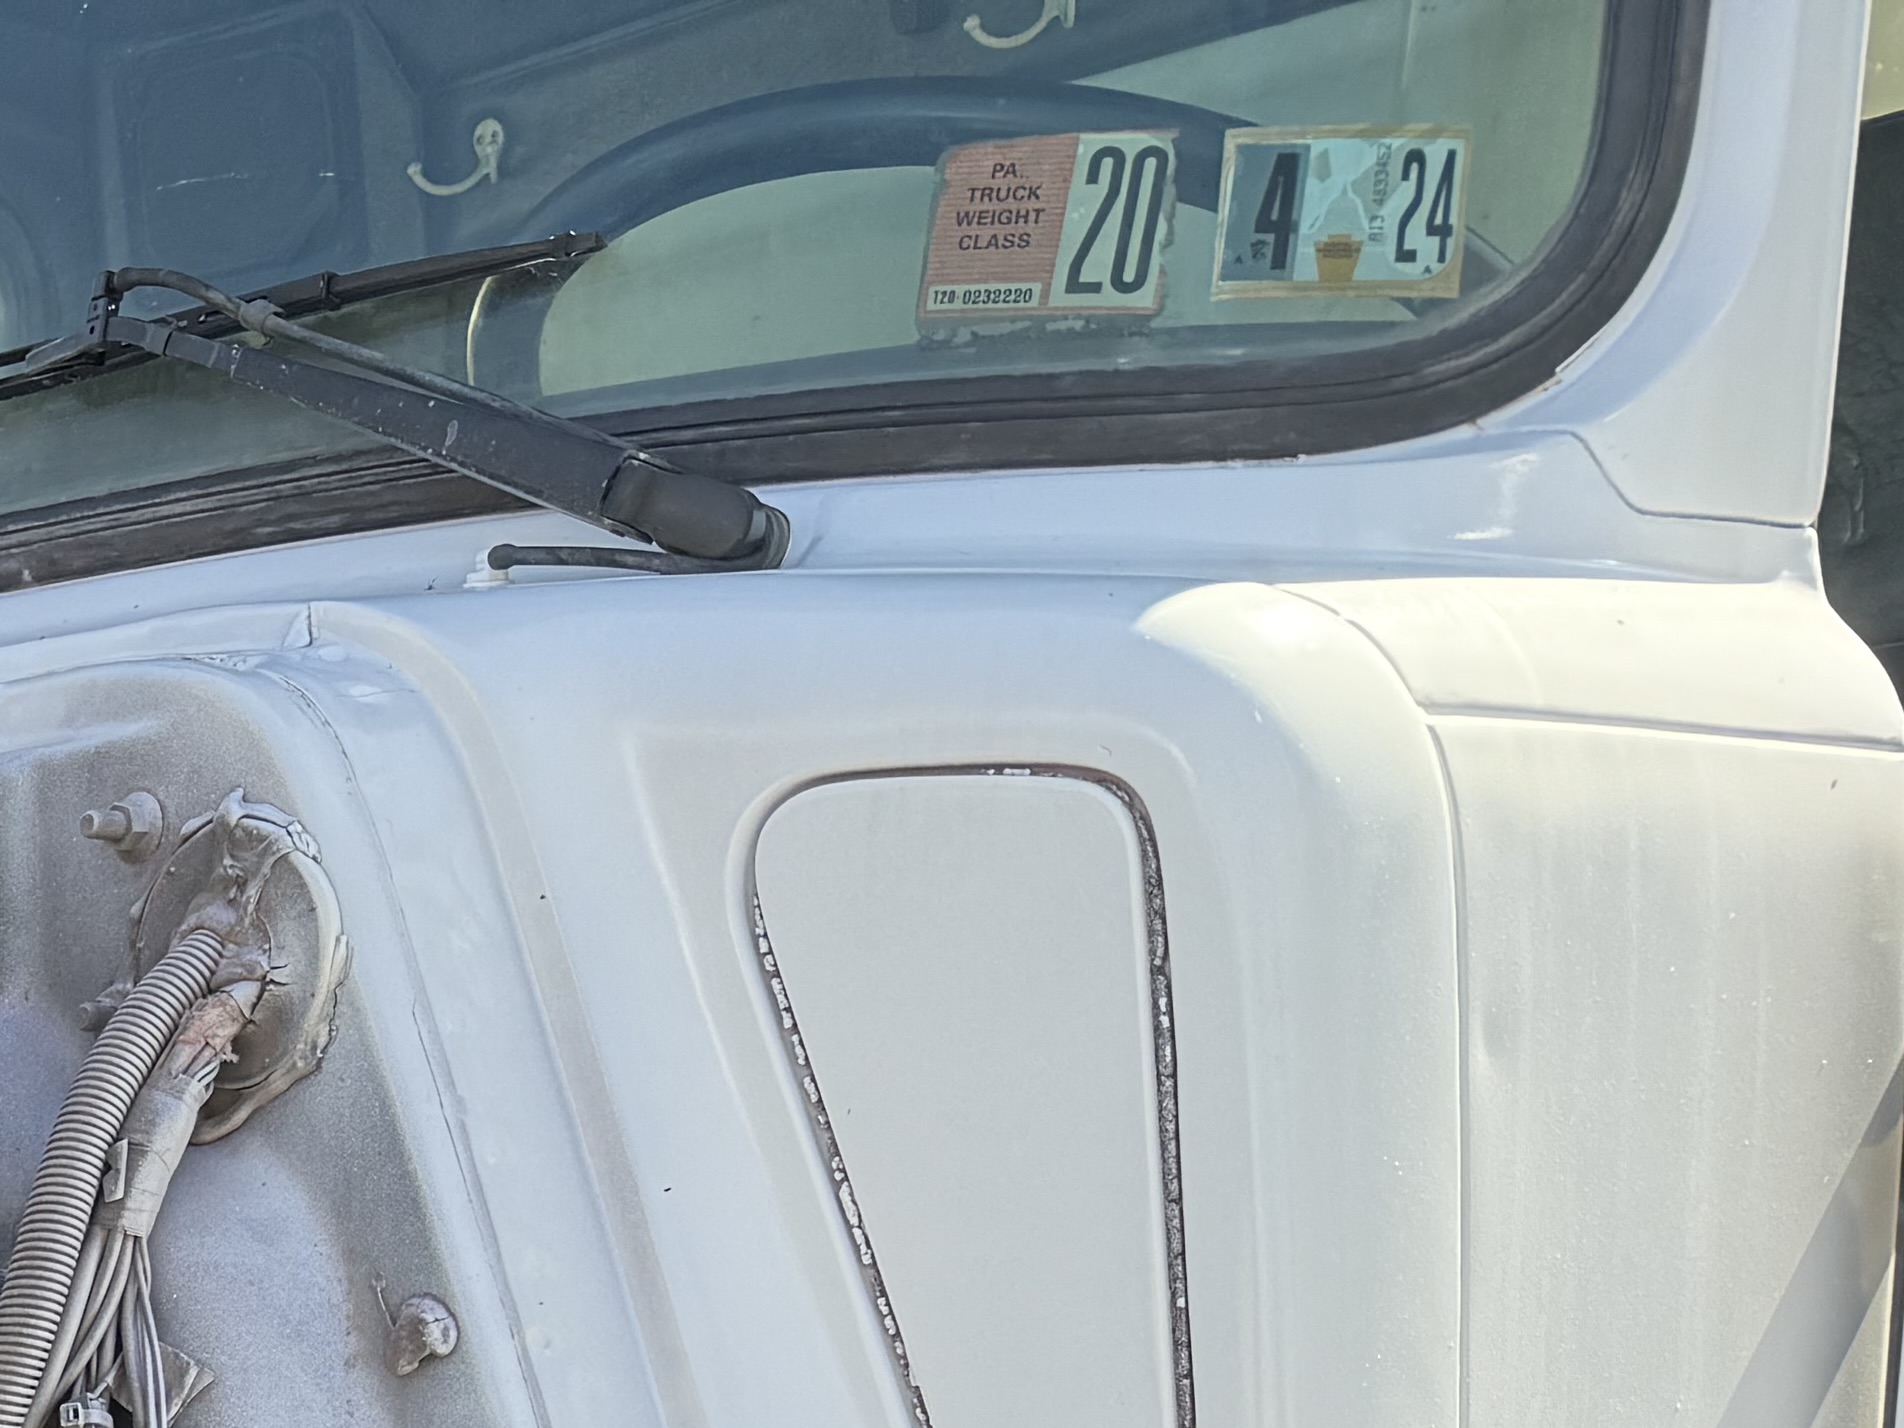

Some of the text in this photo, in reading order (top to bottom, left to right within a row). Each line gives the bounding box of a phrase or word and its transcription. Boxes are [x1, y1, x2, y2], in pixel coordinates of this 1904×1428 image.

[956, 208, 1046, 227] WEIGHT
[967, 185, 1041, 203] TRUCK
[1064, 145, 1169, 294] 20
[1254, 153, 1301, 269] 4
[1394, 147, 1457, 264] 24
[958, 233, 1032, 251] CLASS
